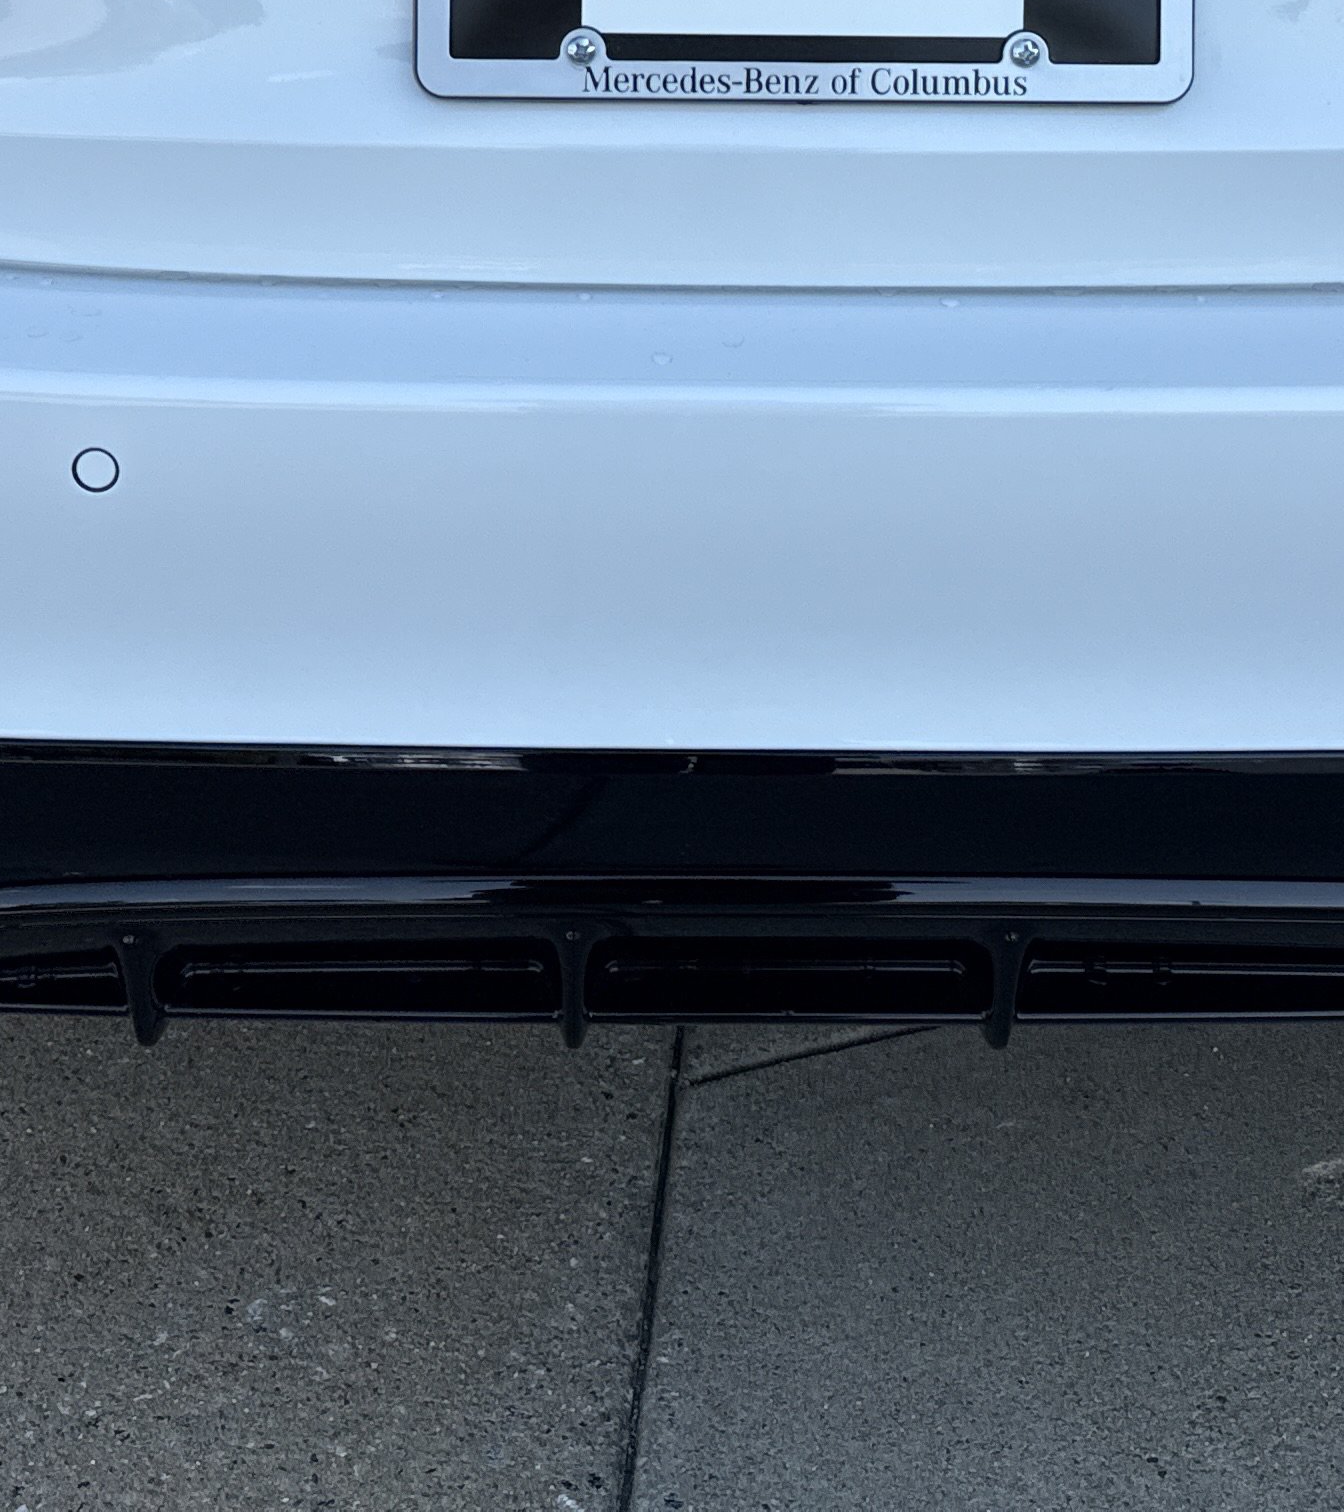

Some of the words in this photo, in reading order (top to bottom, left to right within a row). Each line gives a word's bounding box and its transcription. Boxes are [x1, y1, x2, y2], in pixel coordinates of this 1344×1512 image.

[582, 66, 818, 95] Mercedes-Benz
[831, 67, 862, 95] of
[870, 68, 1027, 97] Columbus
